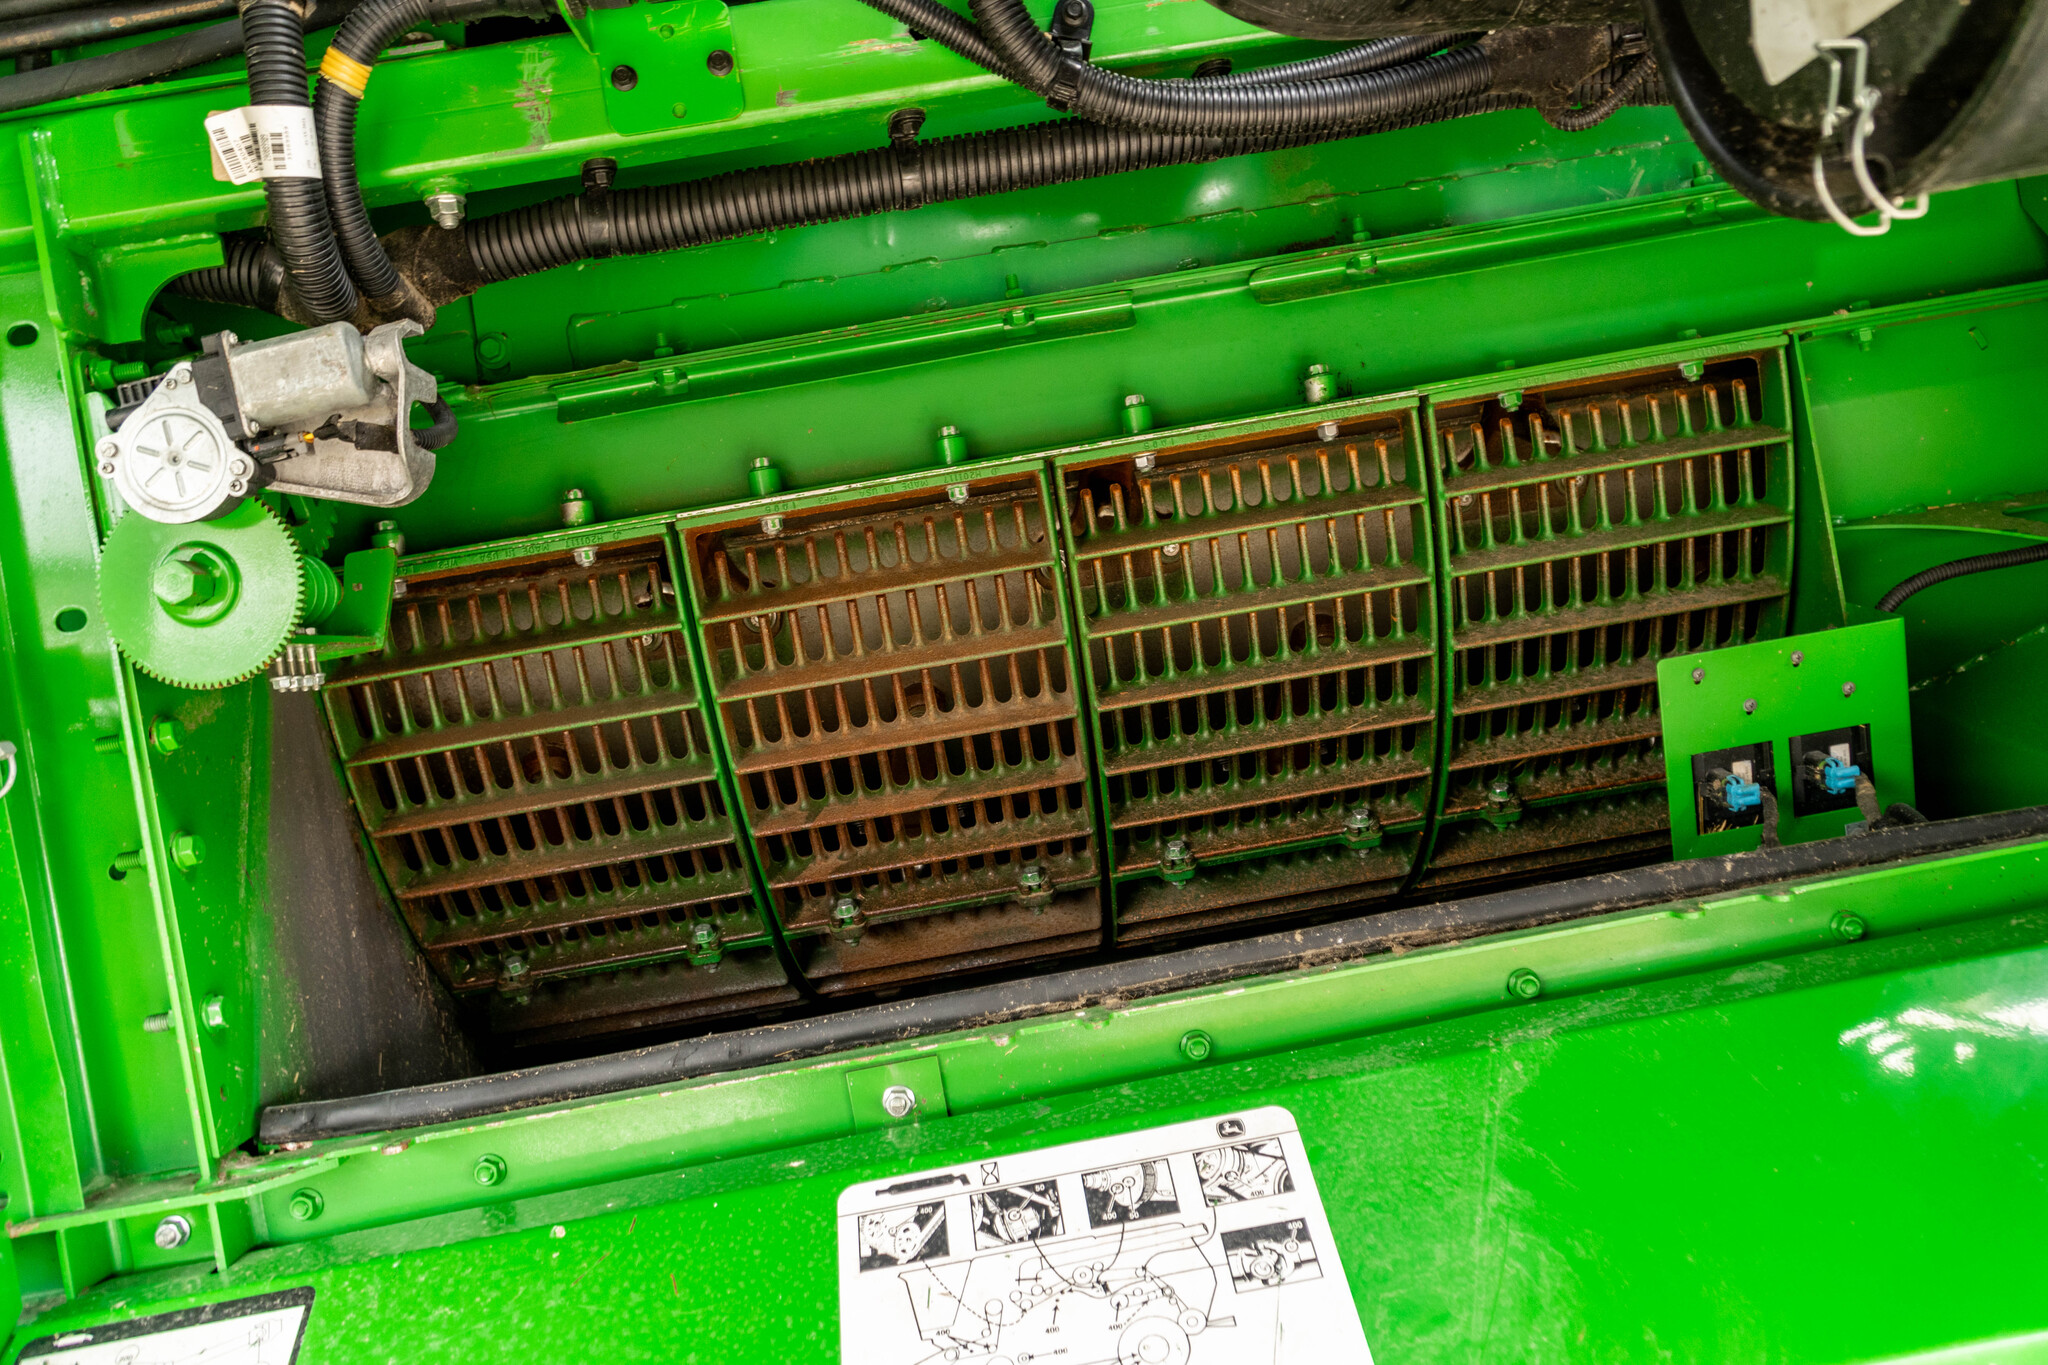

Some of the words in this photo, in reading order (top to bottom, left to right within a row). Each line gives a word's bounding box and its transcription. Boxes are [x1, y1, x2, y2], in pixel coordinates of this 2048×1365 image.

[943, 470, 981, 483] H201117
[901, 478, 928, 490] MADE
[858, 487, 877, 497] USA
[817, 494, 837, 504] WF3
[521, 543, 549, 555] MADE
[478, 551, 499, 562] USA
[436, 558, 457, 569] WF3
[920, 1206, 933, 1215] 400
[1102, 1212, 1117, 1220] 400
[1287, 1221, 1303, 1230] 400
[935, 1328, 950, 1336] 400
[1108, 1323, 1123, 1331] 400
